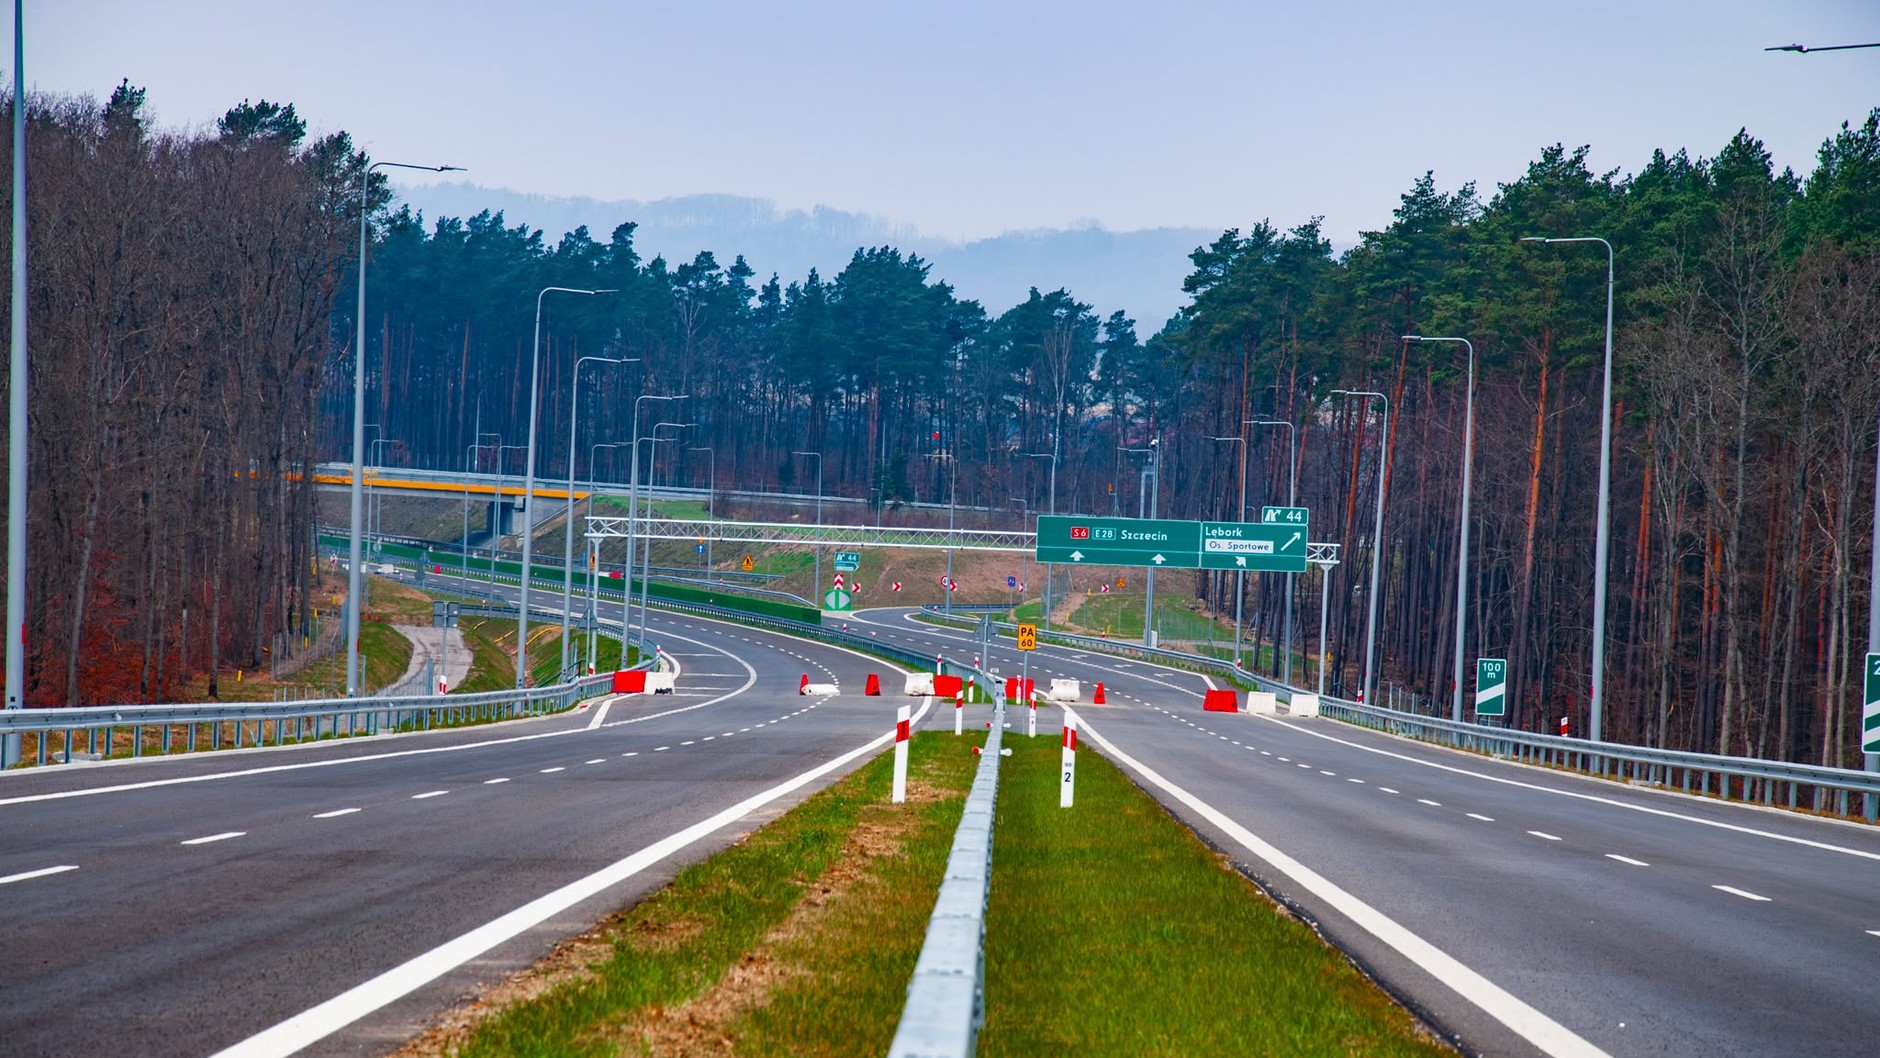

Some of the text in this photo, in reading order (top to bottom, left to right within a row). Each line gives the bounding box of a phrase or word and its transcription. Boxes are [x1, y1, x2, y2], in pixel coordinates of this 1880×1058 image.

[1286, 510, 1302, 522] 44
[1121, 529, 1168, 541] Szczecin
[1205, 526, 1242, 539] Lębork
[1228, 541, 1270, 551] Sportowe
[1020, 627, 1035, 637] PA
[1021, 638, 1033, 647] 60
[1483, 662, 1501, 672] 100
[1064, 771, 1072, 783] 2
